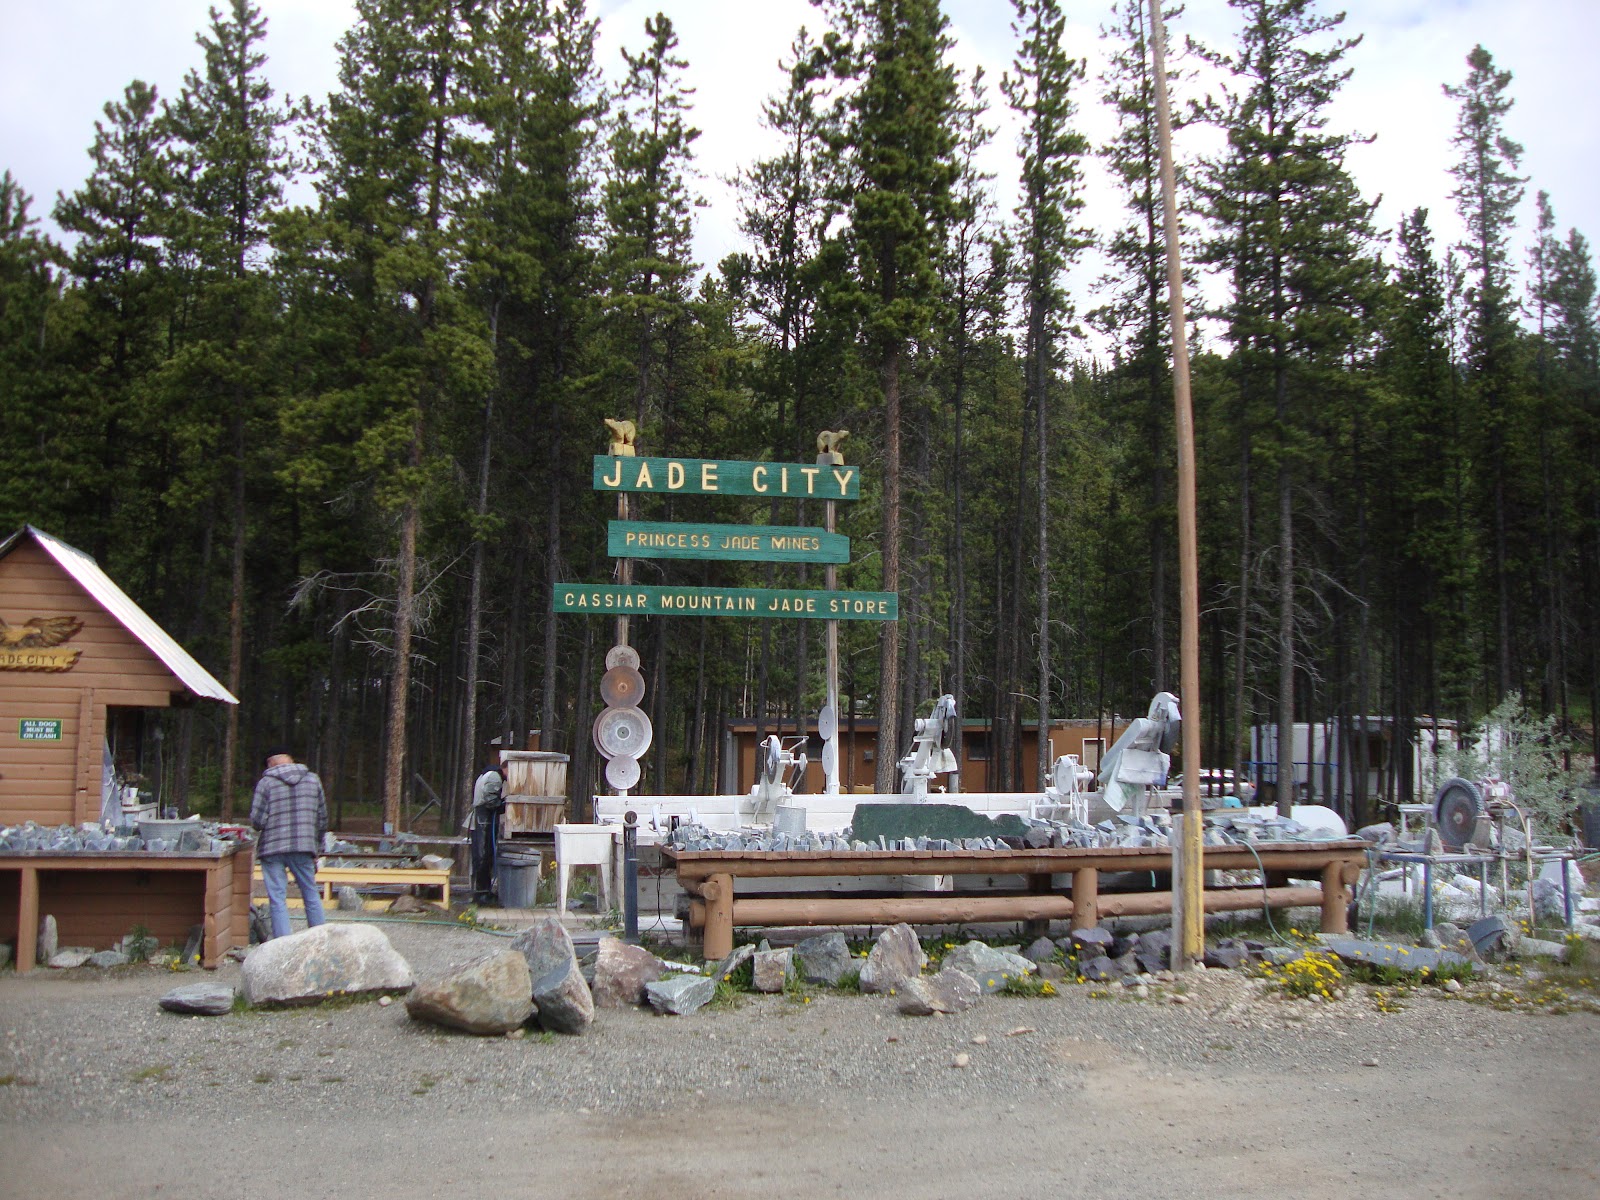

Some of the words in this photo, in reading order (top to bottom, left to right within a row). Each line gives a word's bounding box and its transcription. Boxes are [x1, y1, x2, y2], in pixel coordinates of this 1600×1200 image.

[603, 460, 718, 491] JADE
[752, 466, 853, 496] CITY
[626, 532, 710, 548] PRINCESS
[720, 534, 760, 550] JADE
[771, 536, 820, 551] MINES
[565, 593, 647, 608] CASSIAR
[661, 595, 756, 611] MOUNTAIN
[768, 599, 816, 612] JADE
[829, 600, 888, 614] STORE
[0, 655, 23, 664] ADE
[27, 655, 57, 665] CITY
